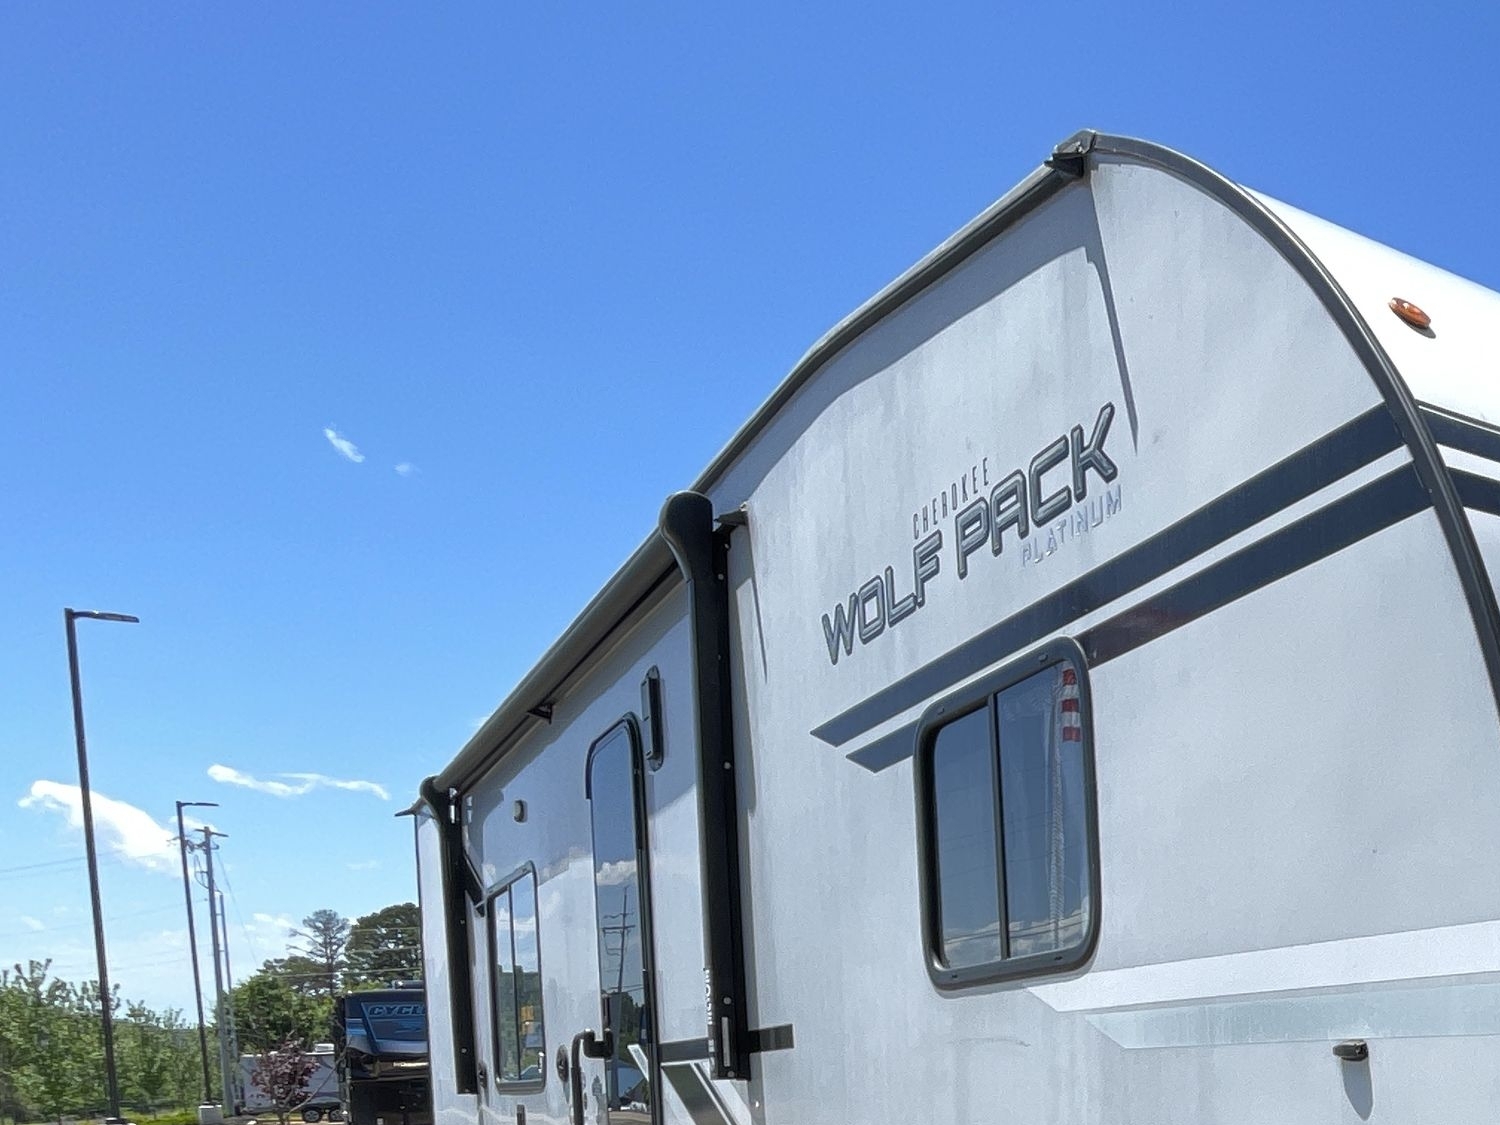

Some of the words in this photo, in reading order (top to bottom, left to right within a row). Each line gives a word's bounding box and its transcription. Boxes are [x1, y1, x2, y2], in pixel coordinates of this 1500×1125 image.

[821, 528, 944, 666] WOLF
[954, 401, 1119, 580] PACK
[913, 456, 990, 541] CHEROKEE
[1022, 484, 1123, 567] PLATINUM
